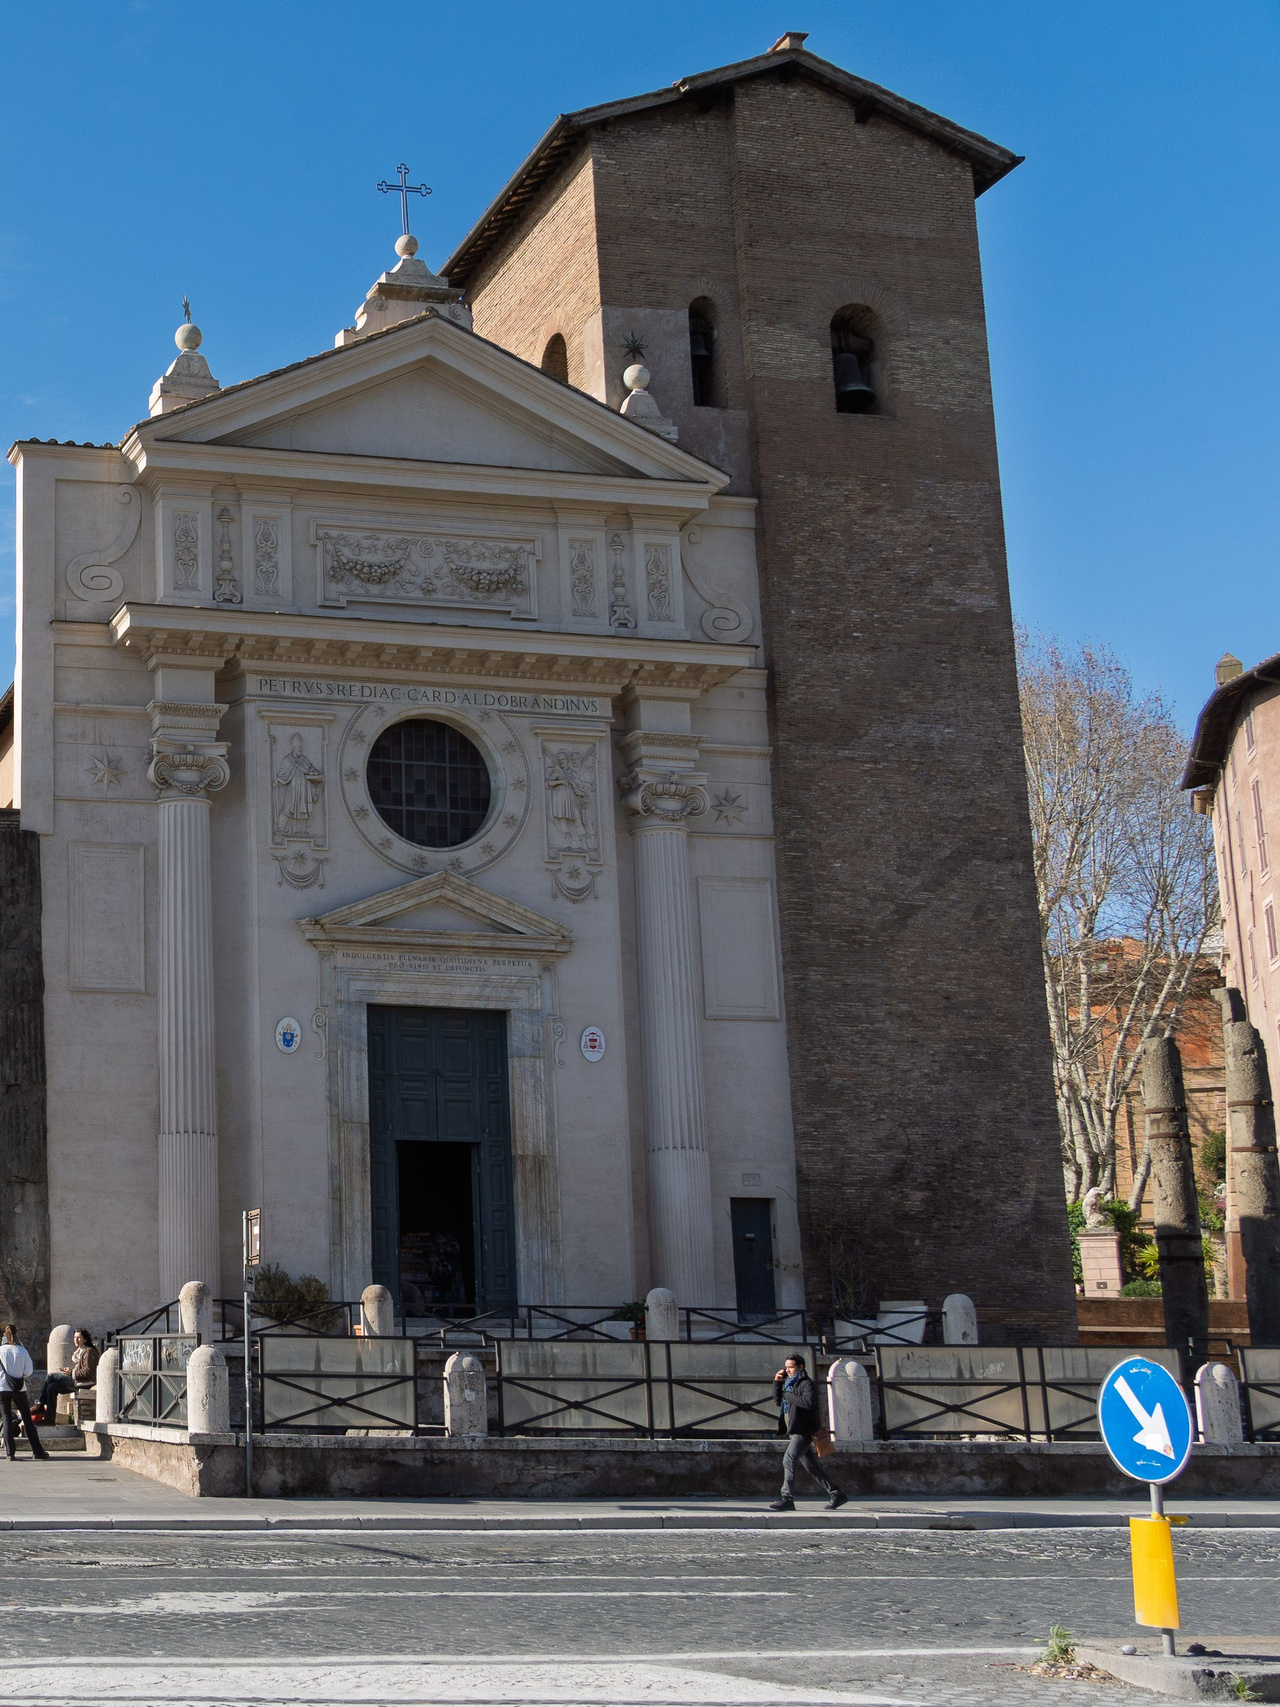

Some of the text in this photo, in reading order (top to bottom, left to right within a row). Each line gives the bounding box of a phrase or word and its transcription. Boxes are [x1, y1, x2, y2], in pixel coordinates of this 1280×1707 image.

[259, 678, 323, 695] PETRVS
[342, 952, 395, 960] INDULGENTIA
[440, 957, 488, 965] QUOTIDIANA
[493, 959, 533, 967] PERPETUA
